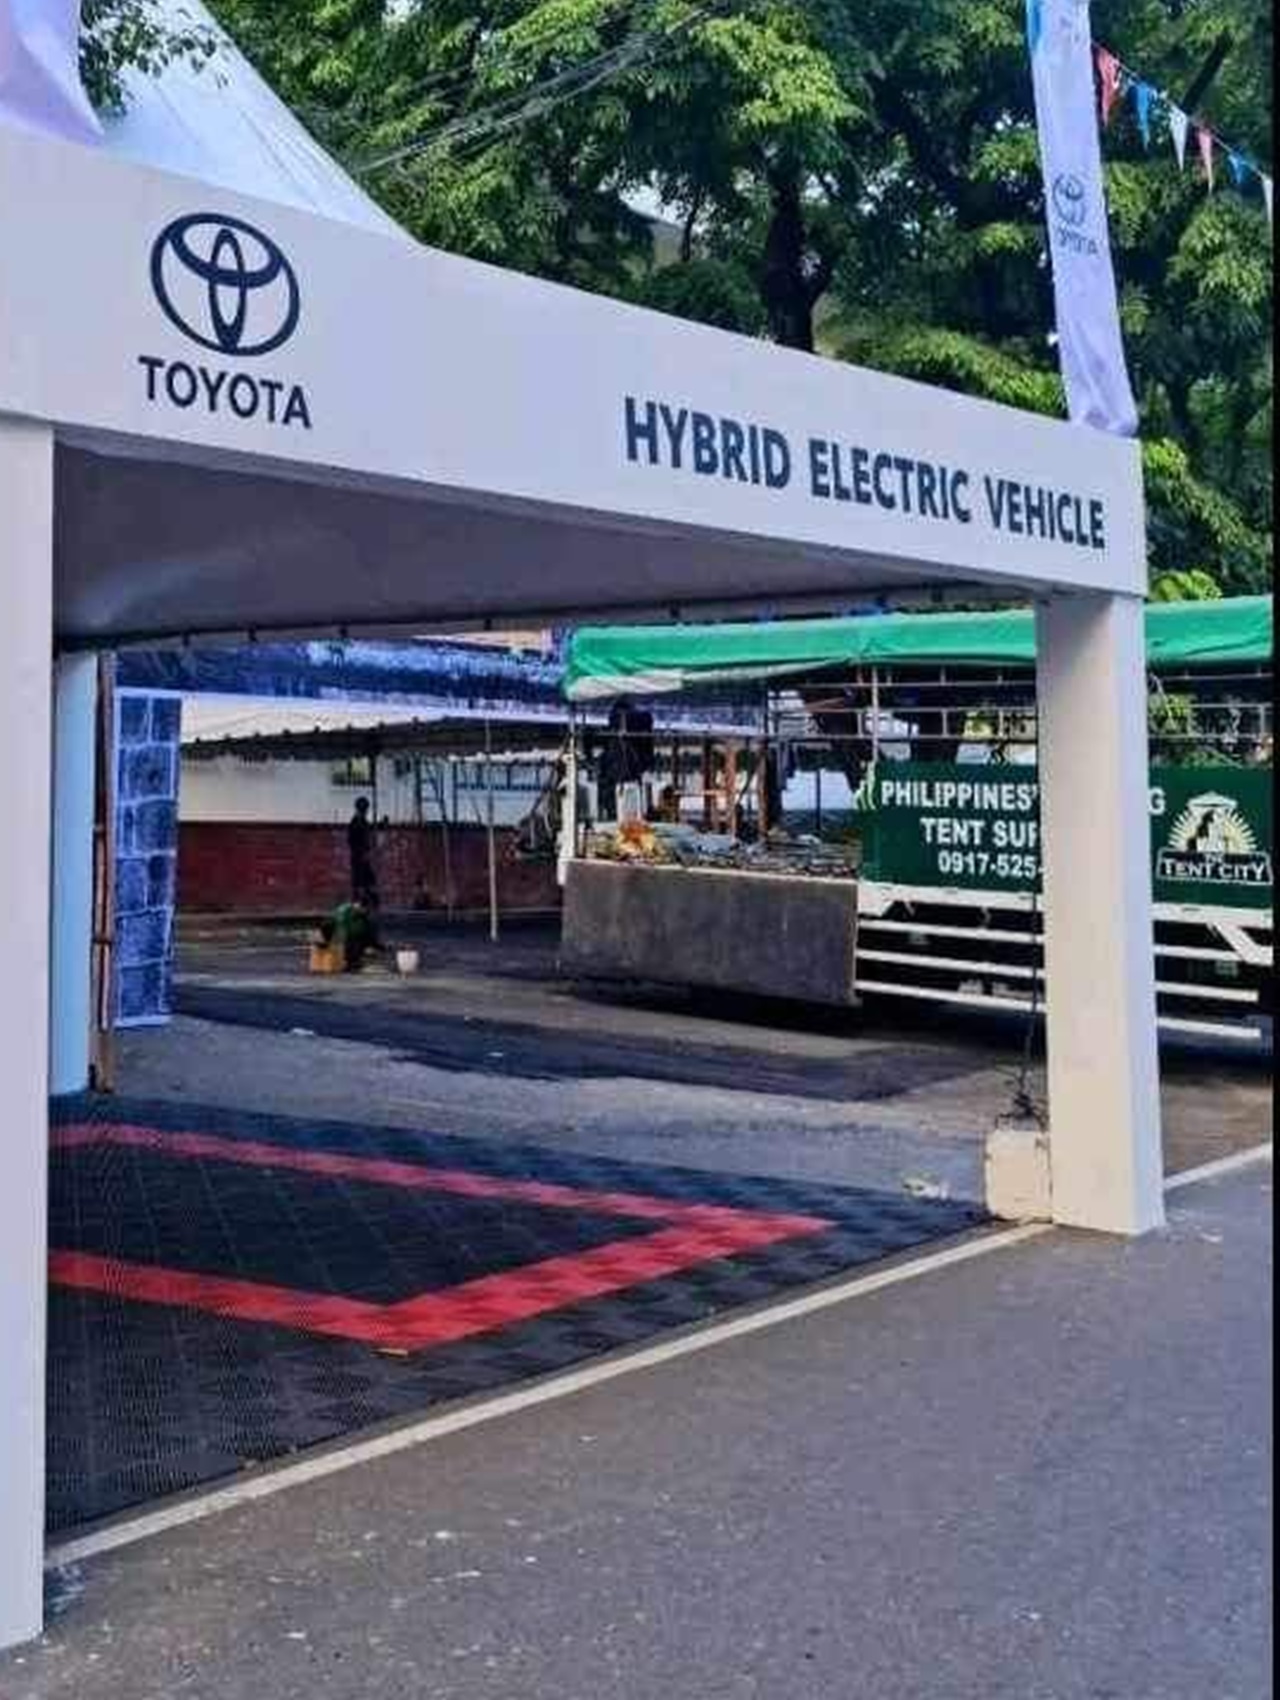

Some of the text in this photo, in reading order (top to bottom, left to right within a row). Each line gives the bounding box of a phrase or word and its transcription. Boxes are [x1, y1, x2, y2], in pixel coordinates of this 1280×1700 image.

[138, 355, 312, 429] TOYOTA
[624, 396, 1106, 549] HYBRID ELECTRIC VEHICLE
[920, 817, 985, 845] TENT
[1163, 856, 1214, 878] TENT
[1218, 861, 1266, 881] CITY
